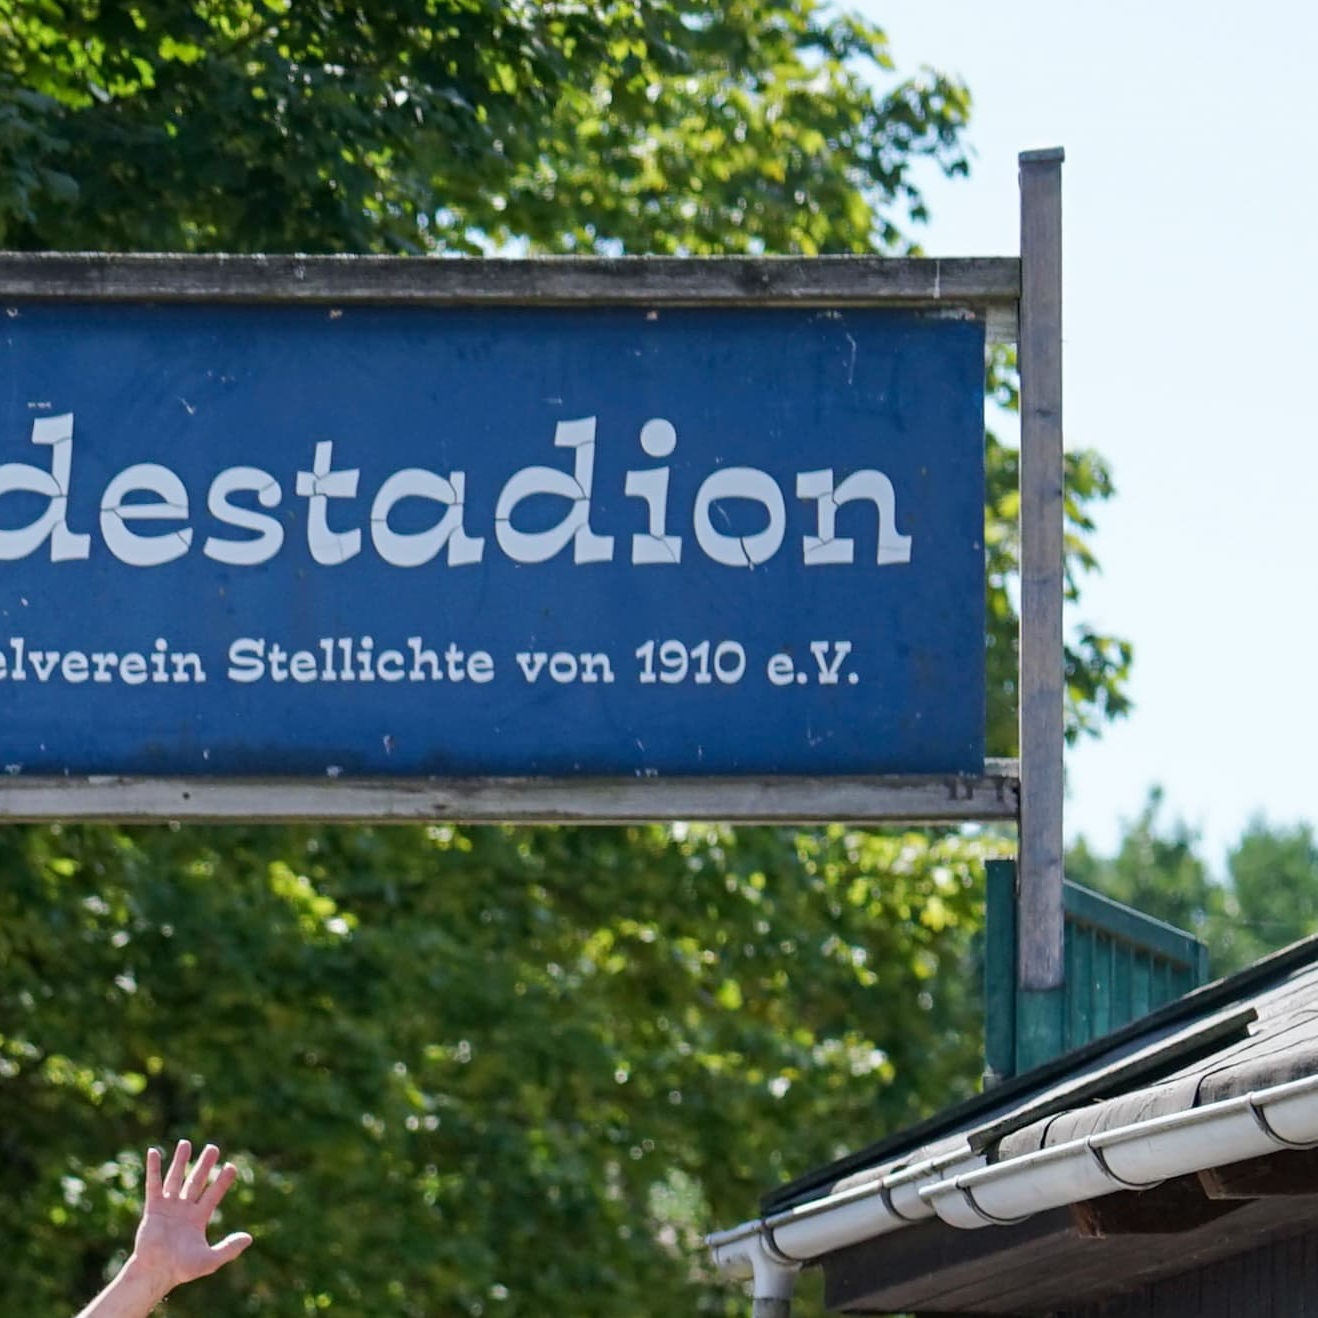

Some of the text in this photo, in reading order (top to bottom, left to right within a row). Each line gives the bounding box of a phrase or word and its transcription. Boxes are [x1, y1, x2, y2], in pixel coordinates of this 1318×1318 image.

[227, 635, 495, 684] Stellichte
[515, 651, 616, 684] von
[634, 639, 747, 685] 1910
[767, 640, 860, 686] e.V.
